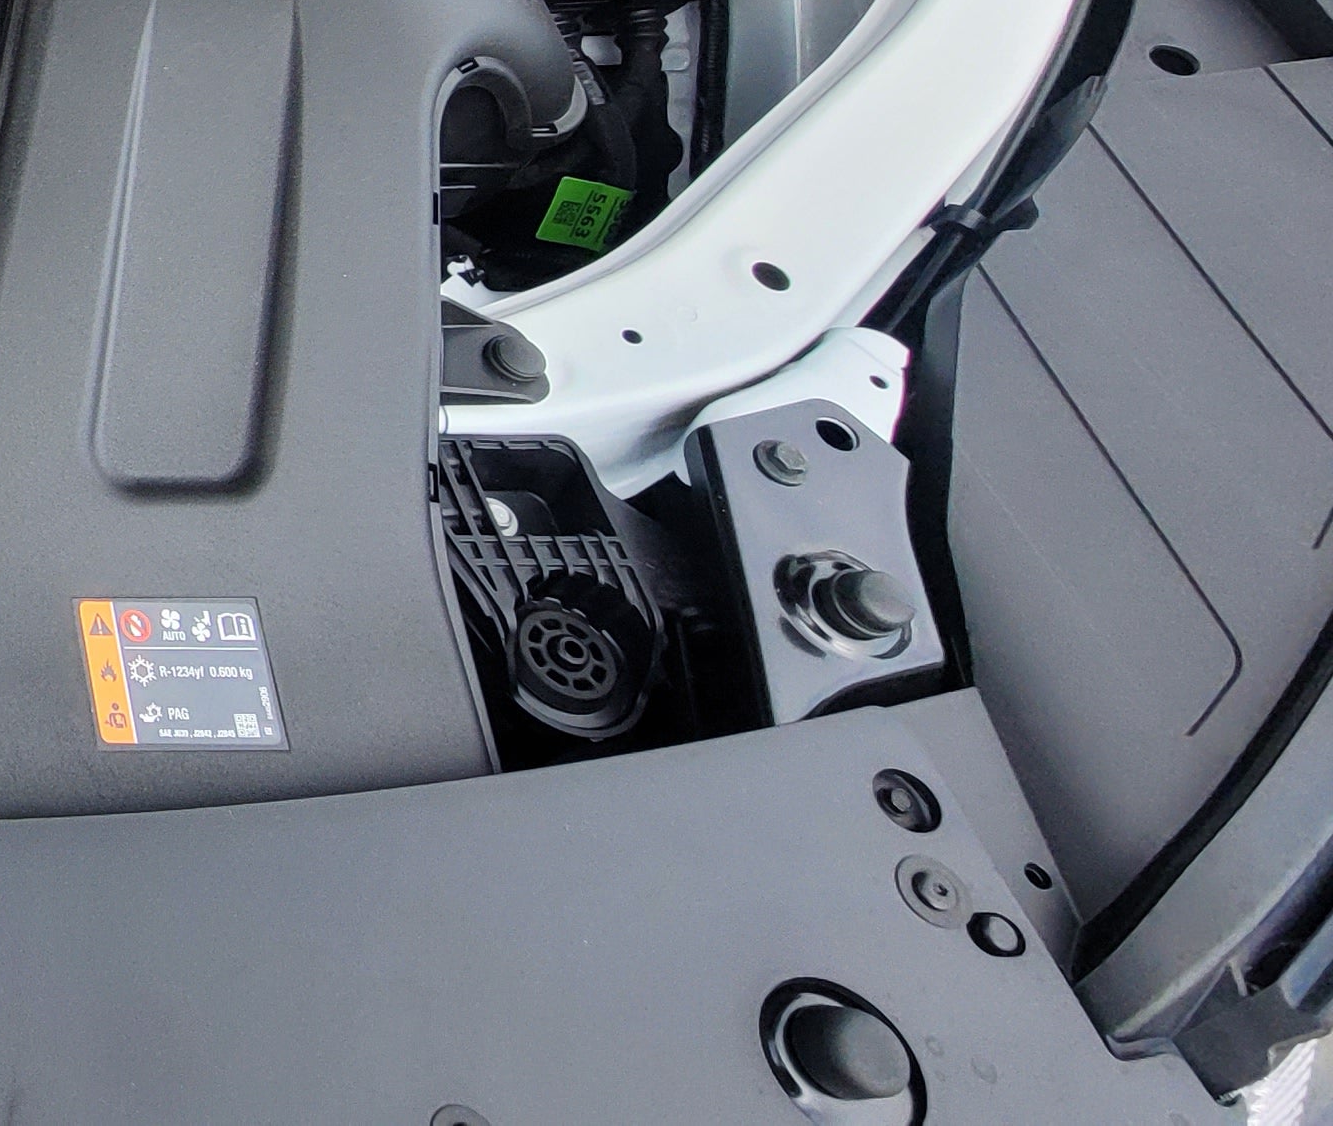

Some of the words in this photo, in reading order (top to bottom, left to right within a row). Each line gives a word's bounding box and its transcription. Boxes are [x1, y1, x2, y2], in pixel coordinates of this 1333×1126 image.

[574, 192, 608, 239] 5563
[162, 630, 186, 641] AUTO
[159, 664, 204, 681] R-1234yf
[209, 665, 237, 678] 0.600
[239, 665, 254, 681] kg
[167, 707, 190, 721] PAG
